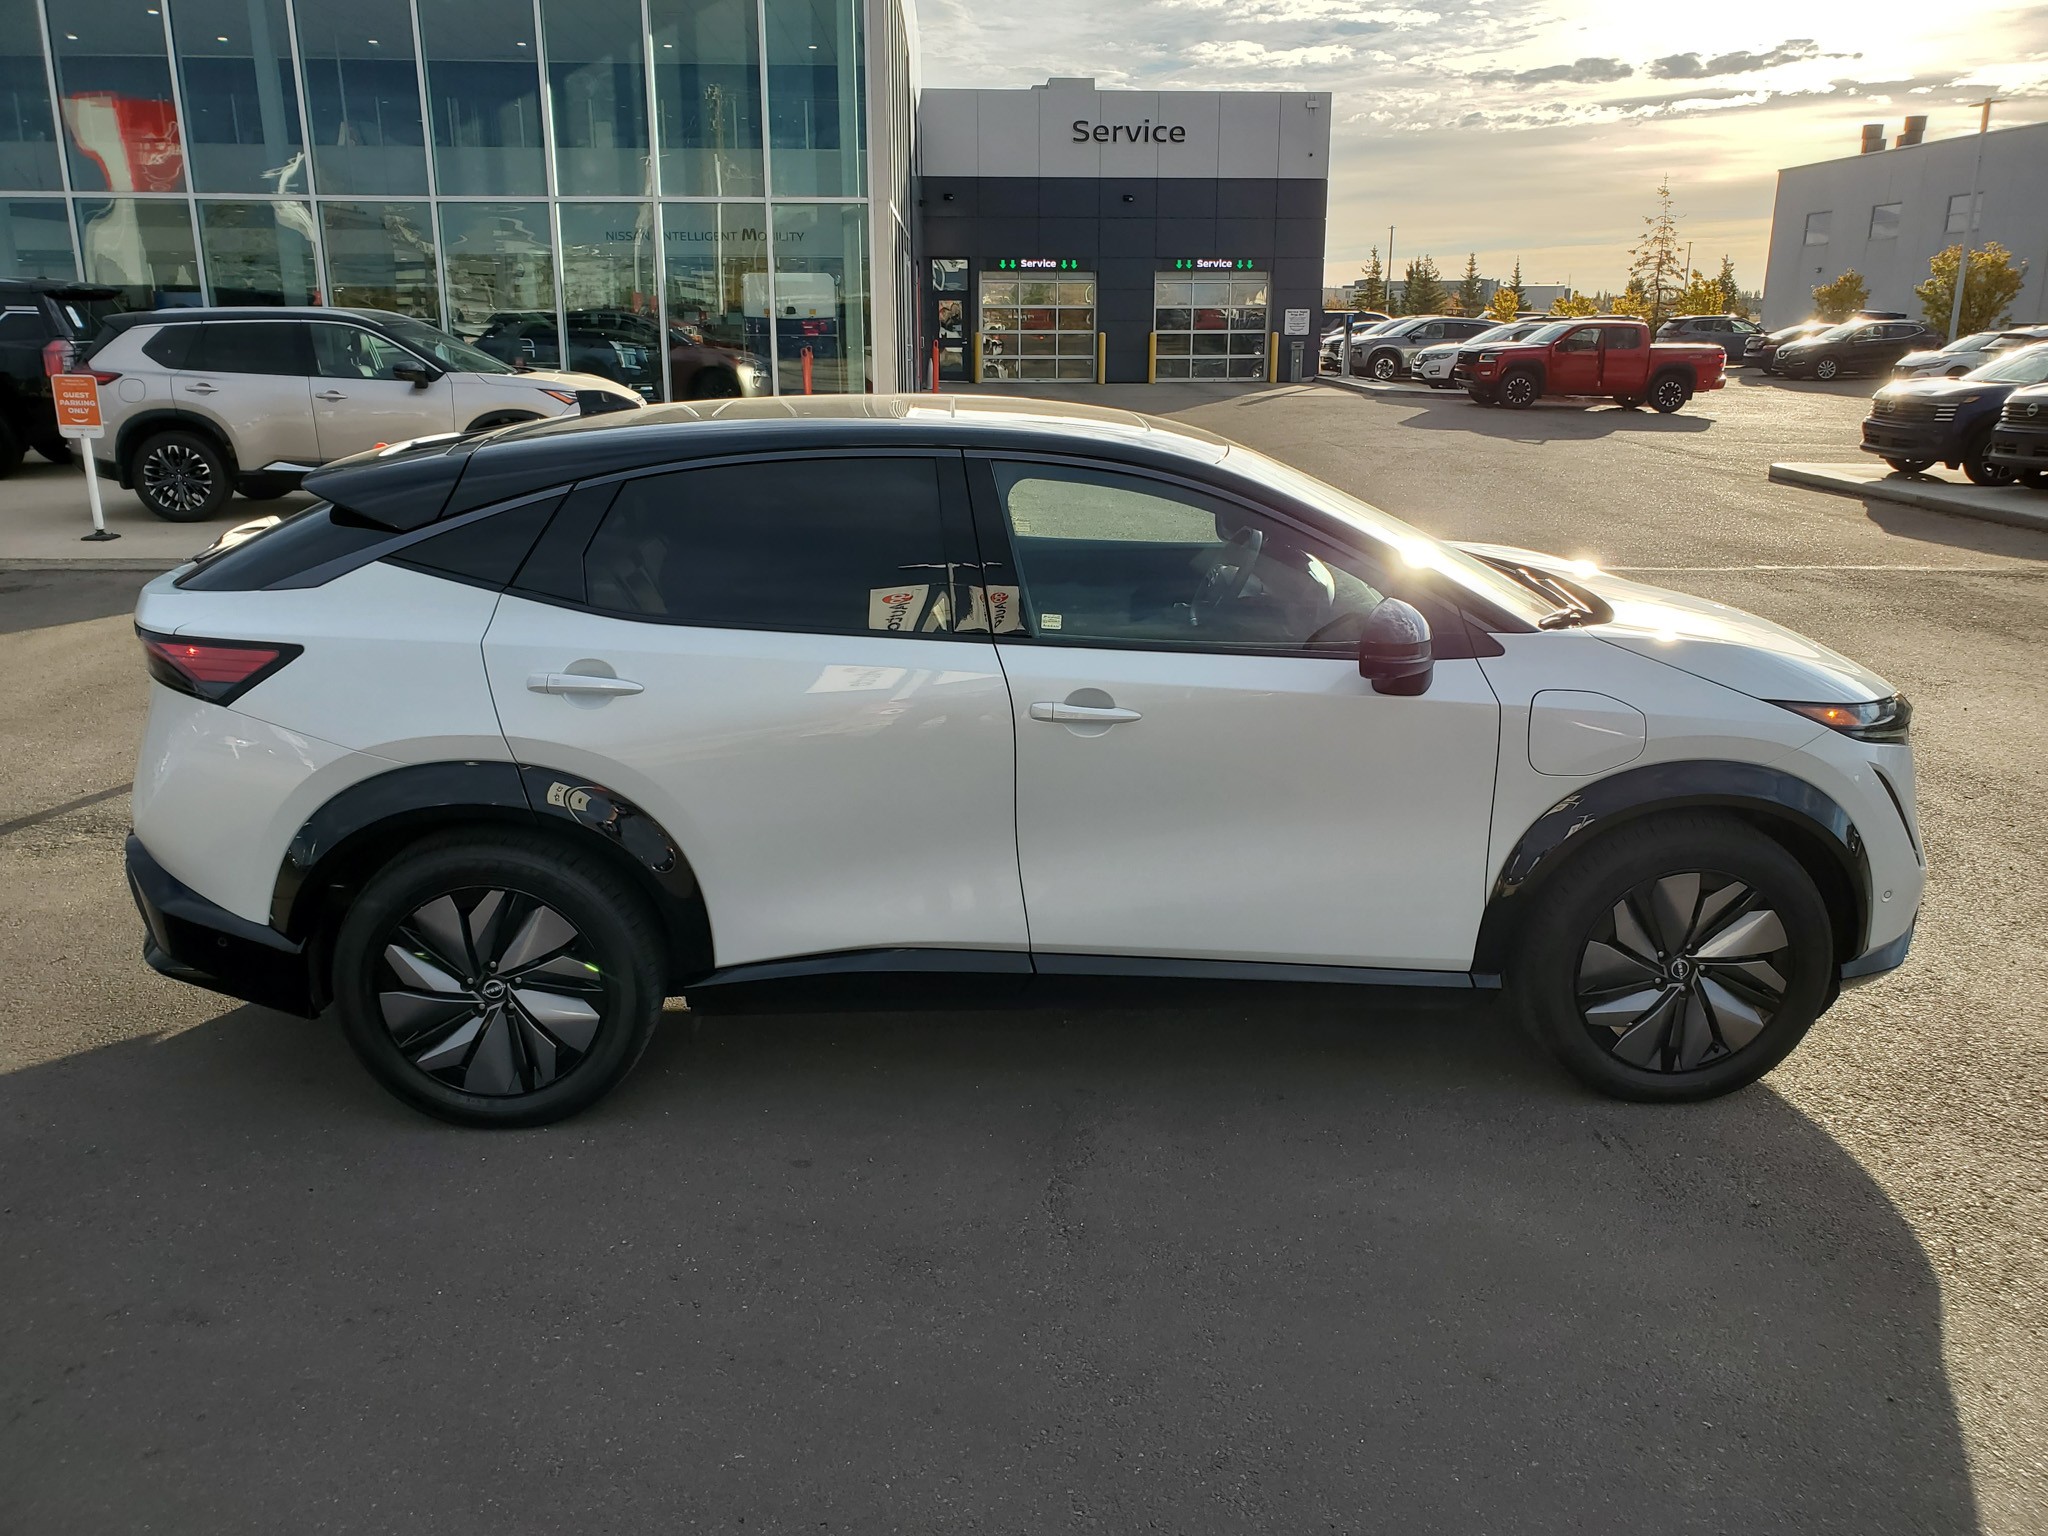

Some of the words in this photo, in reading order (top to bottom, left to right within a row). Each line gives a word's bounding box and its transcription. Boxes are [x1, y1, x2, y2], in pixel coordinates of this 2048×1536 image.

[1072, 119, 1186, 143] Service
[605, 231, 650, 240] NISSAN
[663, 231, 738, 241] NTELLIGENT
[742, 228, 805, 241] MOILITY
[1020, 258, 1057, 268] Service
[1196, 258, 1233, 268] Service
[59, 399, 96, 407] PARKING
